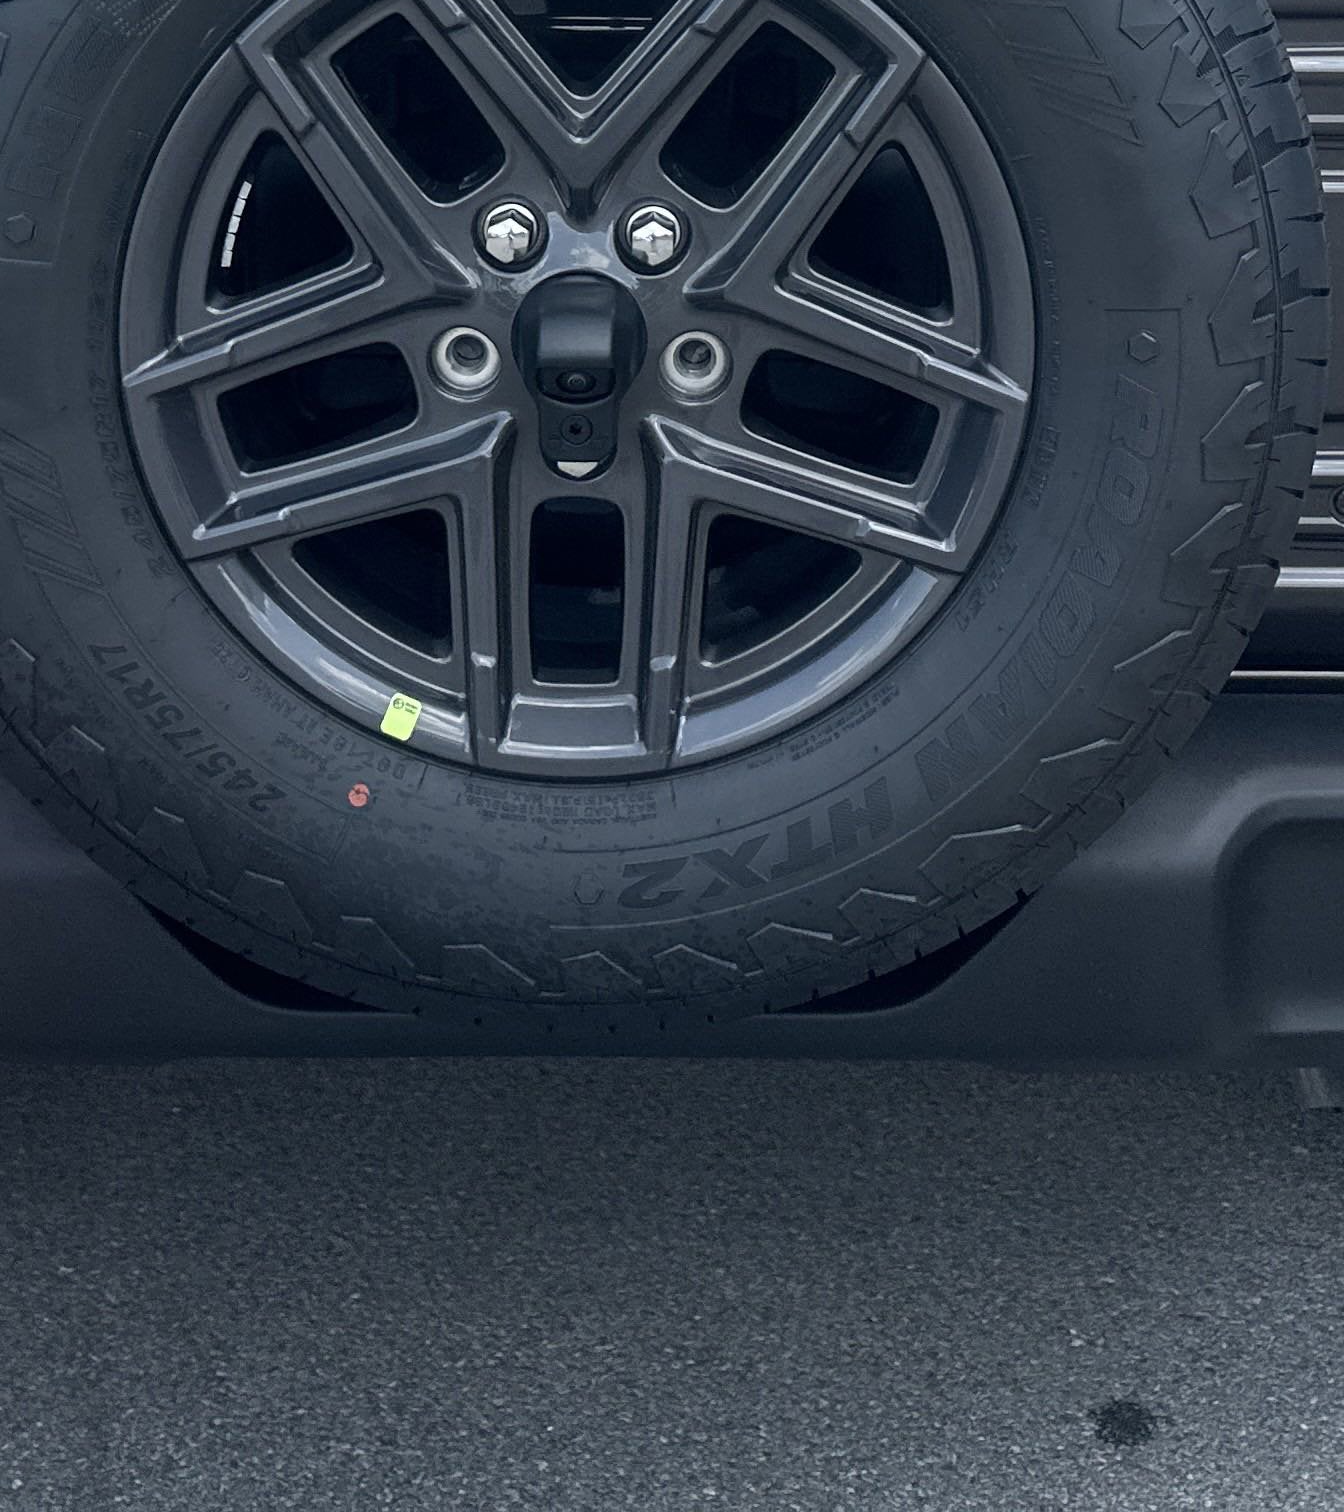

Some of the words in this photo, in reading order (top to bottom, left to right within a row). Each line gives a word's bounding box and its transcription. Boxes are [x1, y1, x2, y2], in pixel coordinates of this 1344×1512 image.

[896, 374, 1177, 803] ROADIAN
[83, 627, 289, 822] 245/75R17
[613, 774, 914, 914] HTX2
